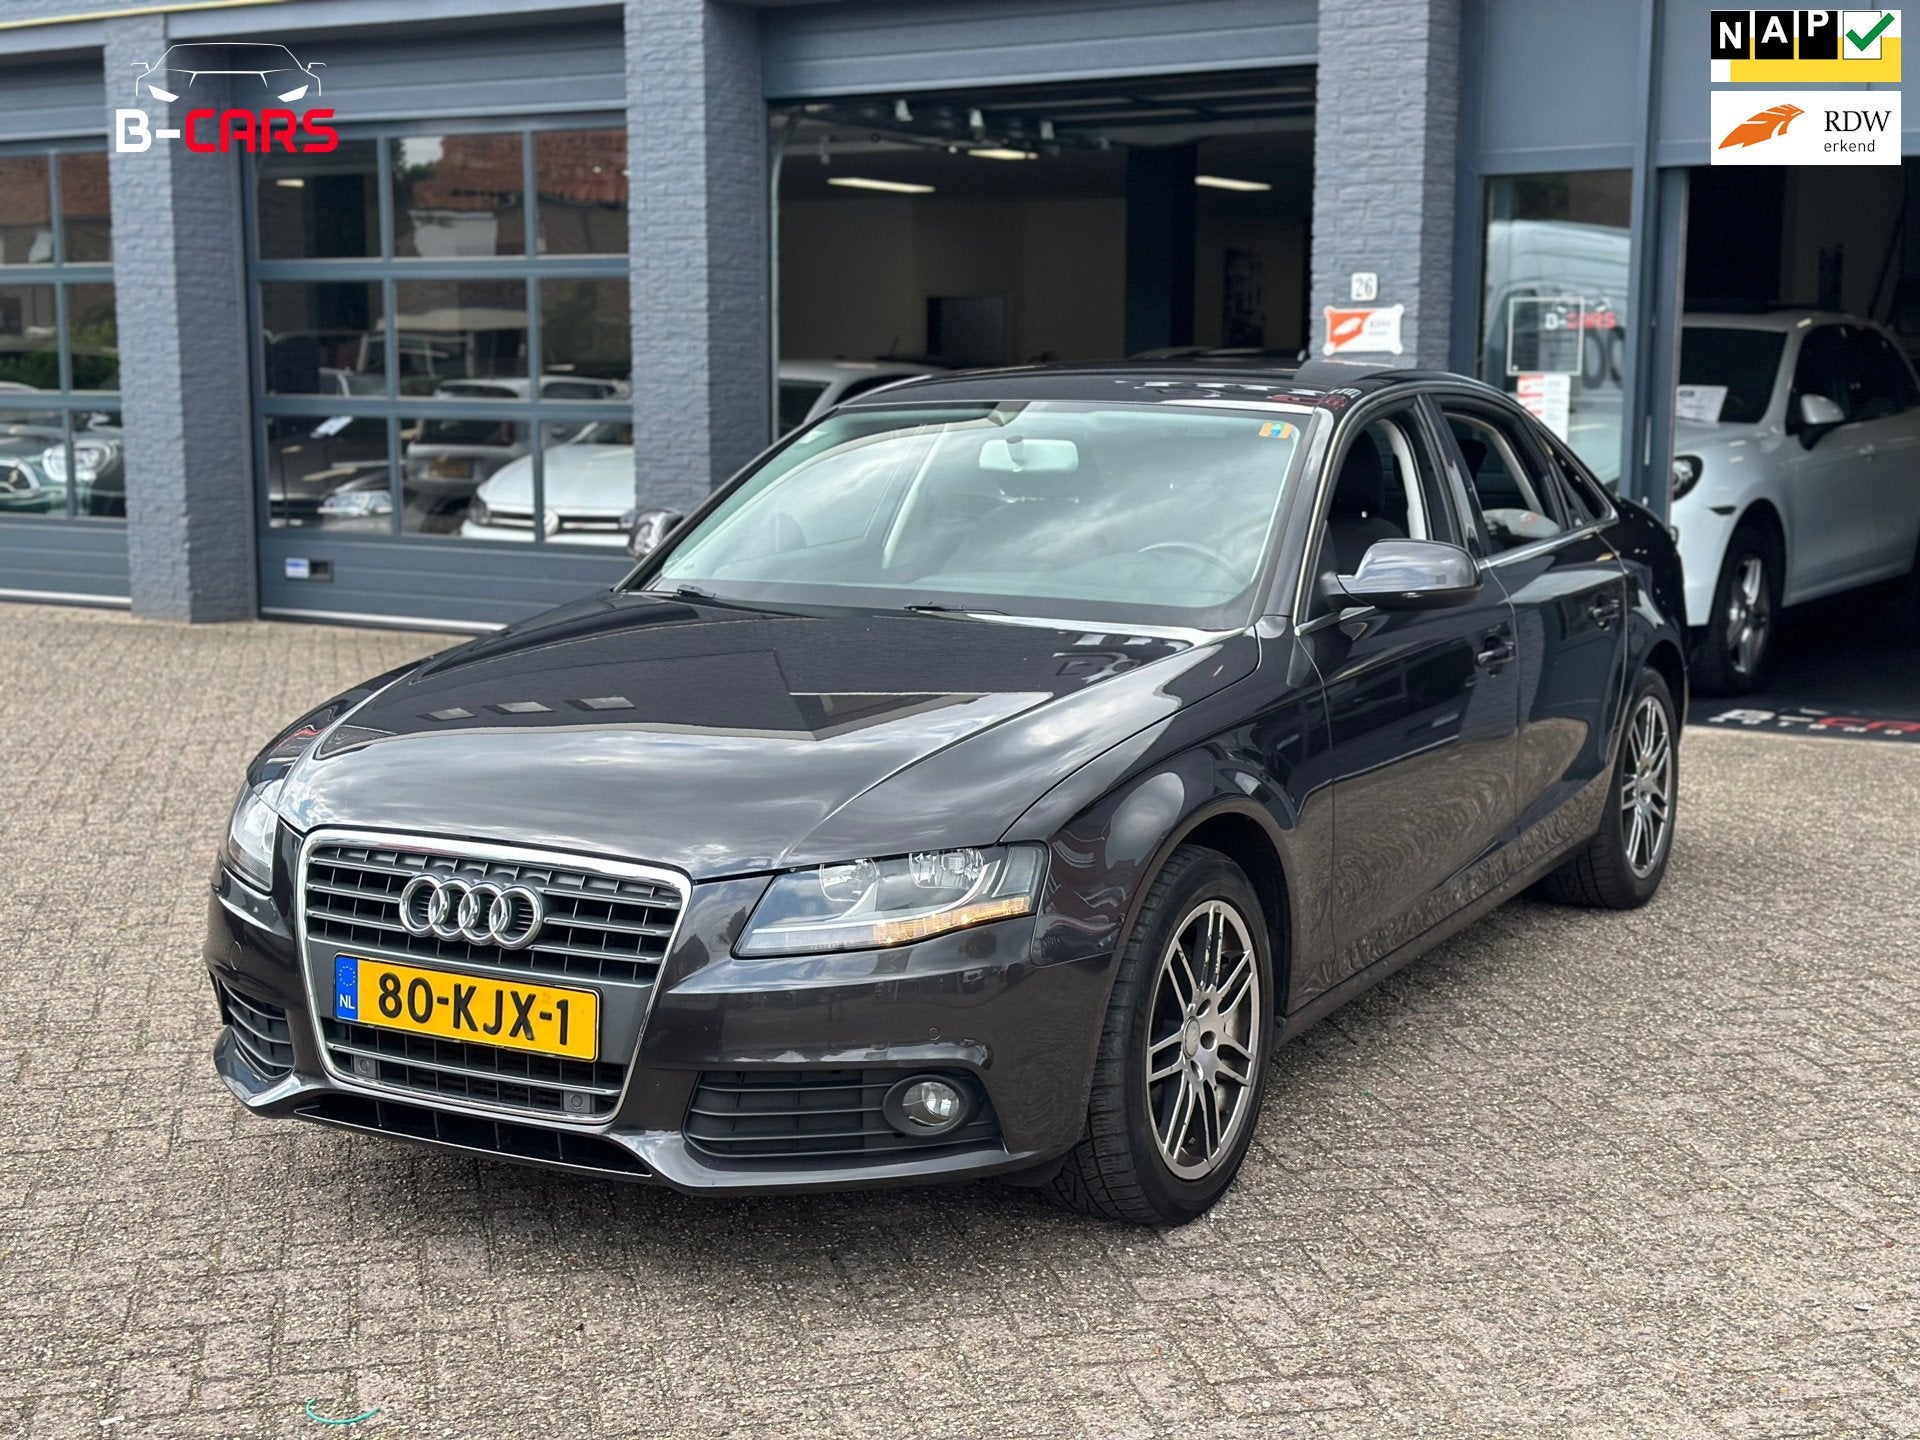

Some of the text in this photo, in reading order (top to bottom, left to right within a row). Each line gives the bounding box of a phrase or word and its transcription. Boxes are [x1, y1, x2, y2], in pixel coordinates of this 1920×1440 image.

[1355, 276, 1374, 298] 26
[339, 994, 355, 1010] NL
[378, 972, 569, 1045] 80-KJX-1
